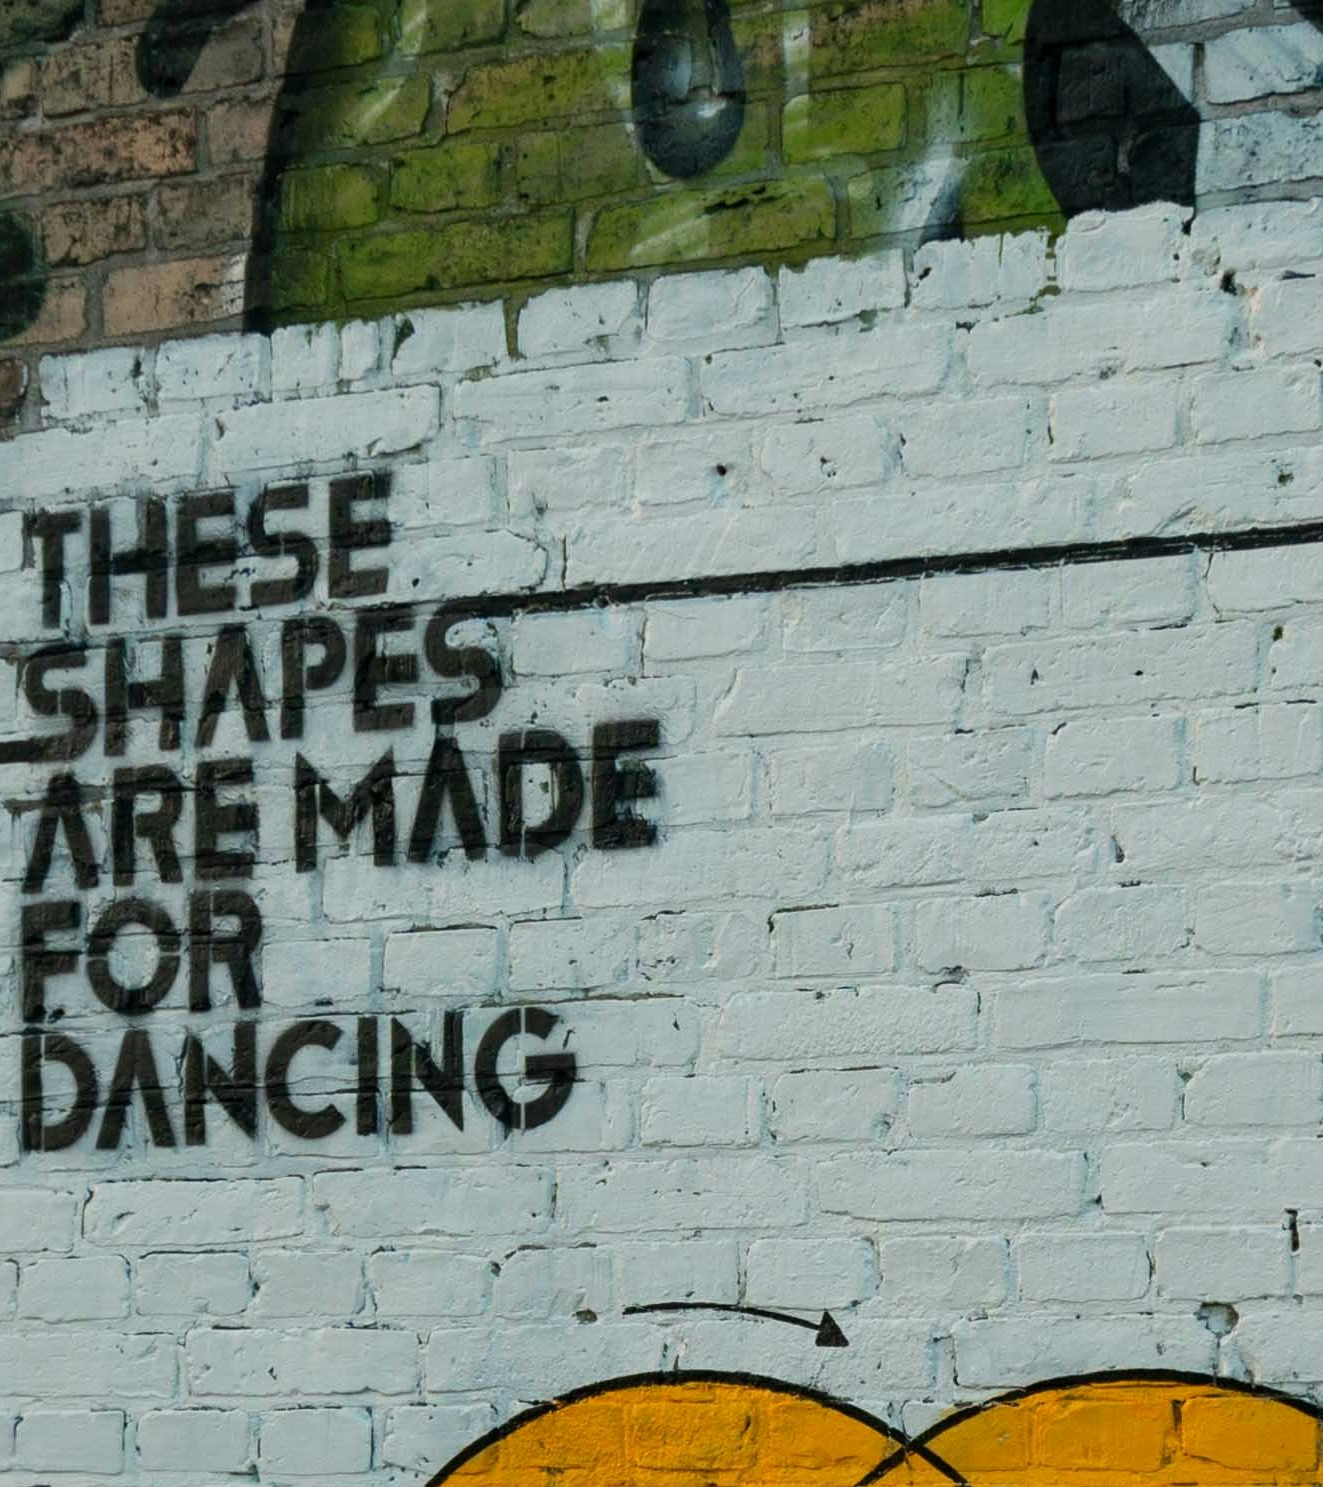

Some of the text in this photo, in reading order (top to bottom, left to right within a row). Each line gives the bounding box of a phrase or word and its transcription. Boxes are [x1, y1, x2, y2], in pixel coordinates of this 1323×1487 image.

[31, 468, 393, 630] THESE
[23, 603, 504, 761] SHAPES
[21, 718, 661, 894] ARE MADE
[20, 890, 265, 1024] FOR
[20, 1007, 577, 1153] DANCING
